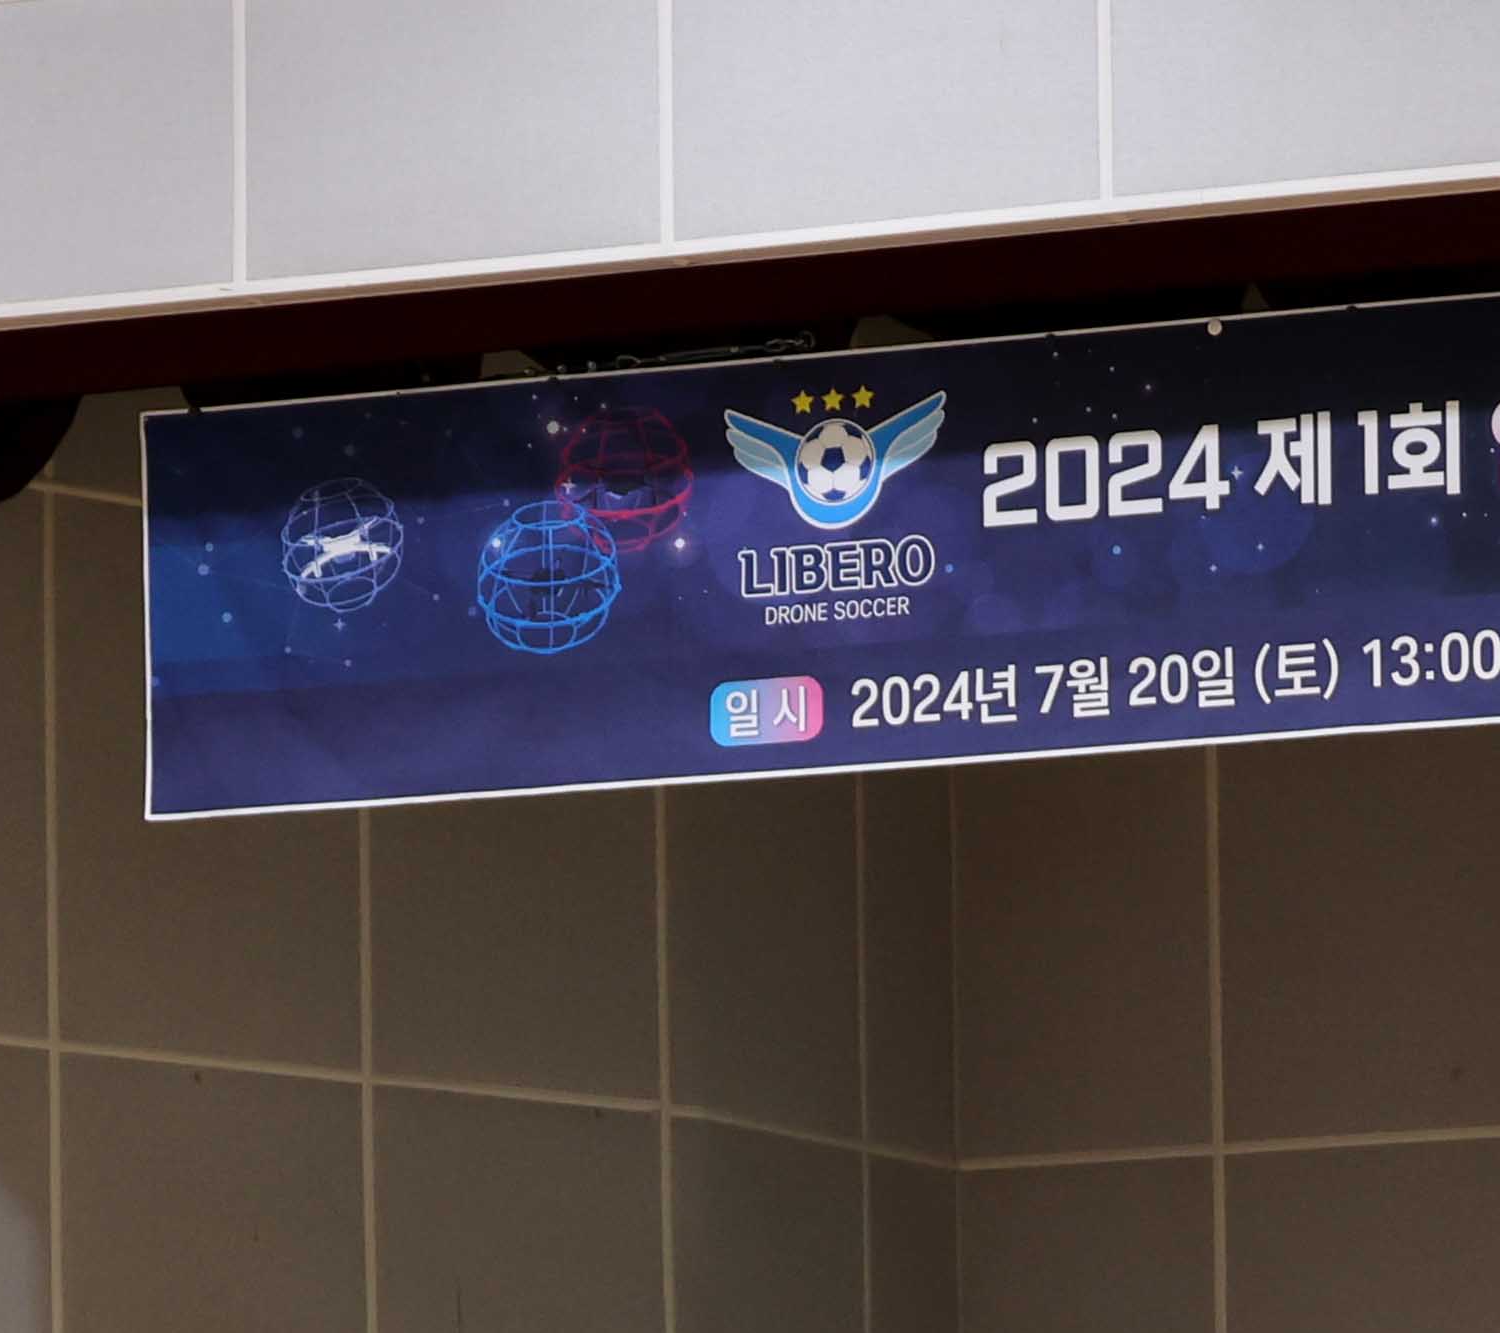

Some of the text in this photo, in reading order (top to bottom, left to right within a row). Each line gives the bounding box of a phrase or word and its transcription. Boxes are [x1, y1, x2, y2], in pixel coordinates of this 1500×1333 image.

[982, 424, 1231, 528] 2024
[1253, 423, 1332, 506] 제
[1357, 400, 1461, 495] 1회
[737, 534, 936, 601] LIBERO
[765, 595, 910, 626] DRONE SOCCER
[851, 664, 1018, 728] 2024년
[1034, 656, 1110, 718] 7월
[1128, 646, 1236, 708] 20일
[1254, 638, 1339, 705] (토)
